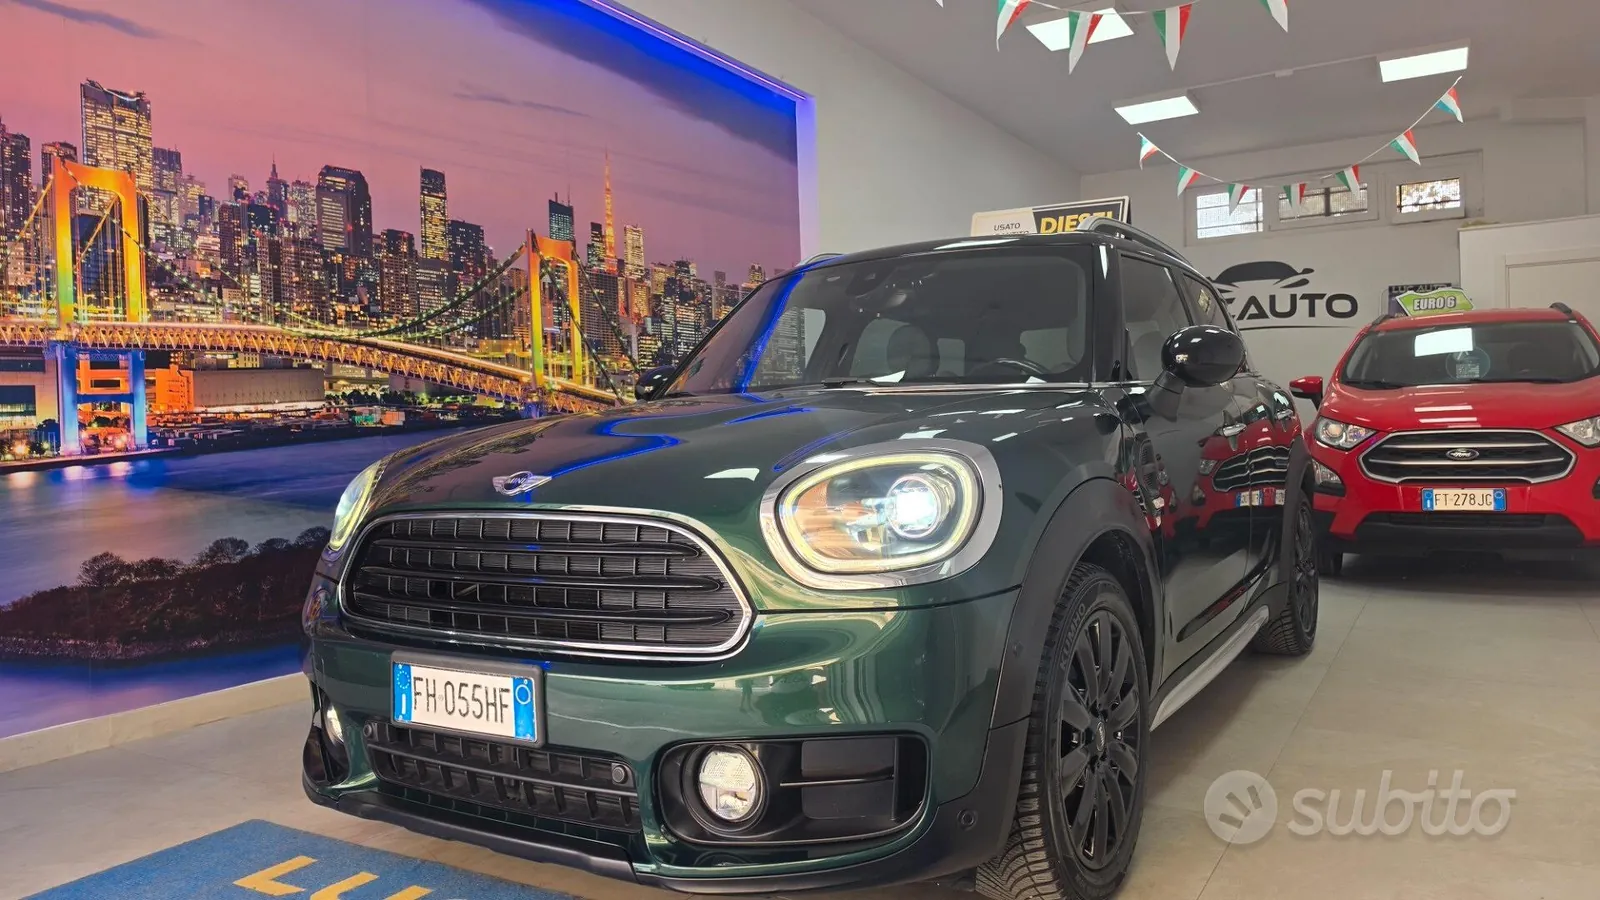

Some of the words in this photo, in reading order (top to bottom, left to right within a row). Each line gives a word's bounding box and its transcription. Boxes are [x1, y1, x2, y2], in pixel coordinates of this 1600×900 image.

[993, 222, 1021, 231] USATO
[1040, 211, 1113, 234] DIE
[1416, 283, 1446, 292] AUT
[1413, 297, 1444, 310] EURO
[1446, 296, 1456, 308] 6
[1435, 493, 1449, 506] FT
[1060, 603, 1085, 671] KUMHO
[413, 676, 437, 713] FH
[444, 680, 511, 724] 055HF
